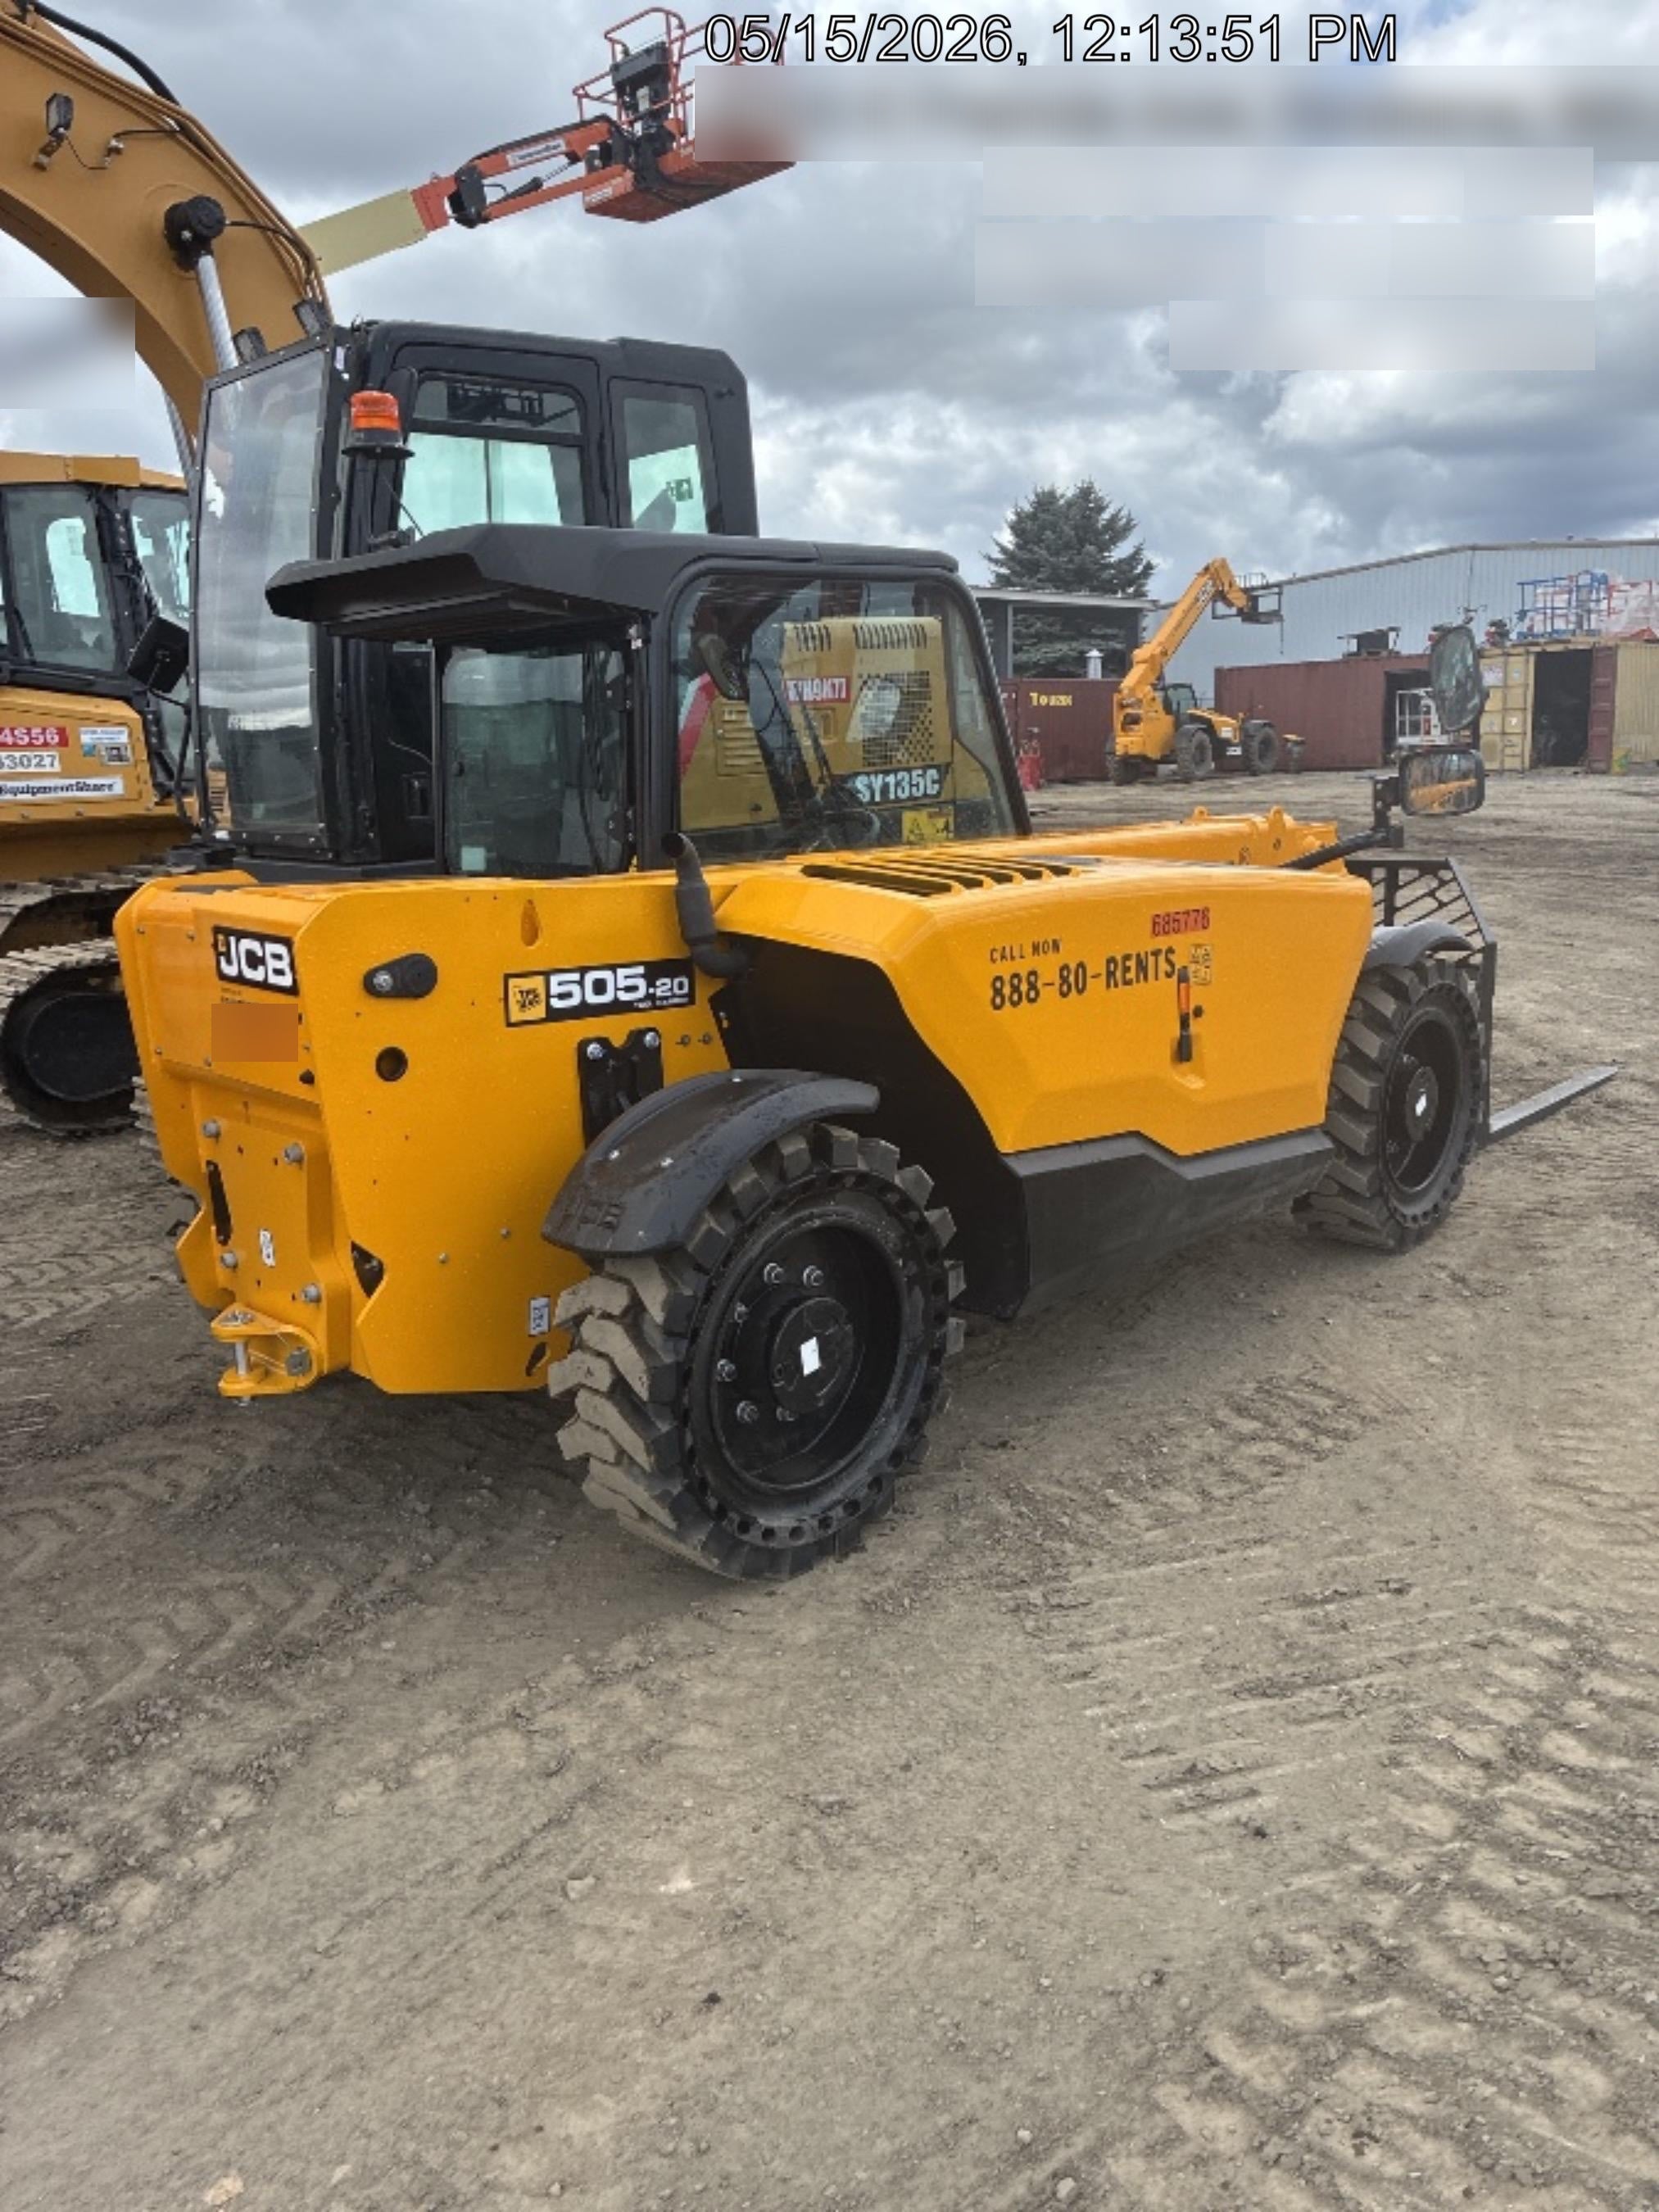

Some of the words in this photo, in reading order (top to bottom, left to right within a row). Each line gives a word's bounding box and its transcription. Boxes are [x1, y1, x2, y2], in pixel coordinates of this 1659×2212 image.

[854, 768, 941, 802] SY135C
[219, 935, 293, 988] JCB
[990, 945, 1026, 964] CALL
[990, 945, 1176, 1011] 888-80-RENTS
